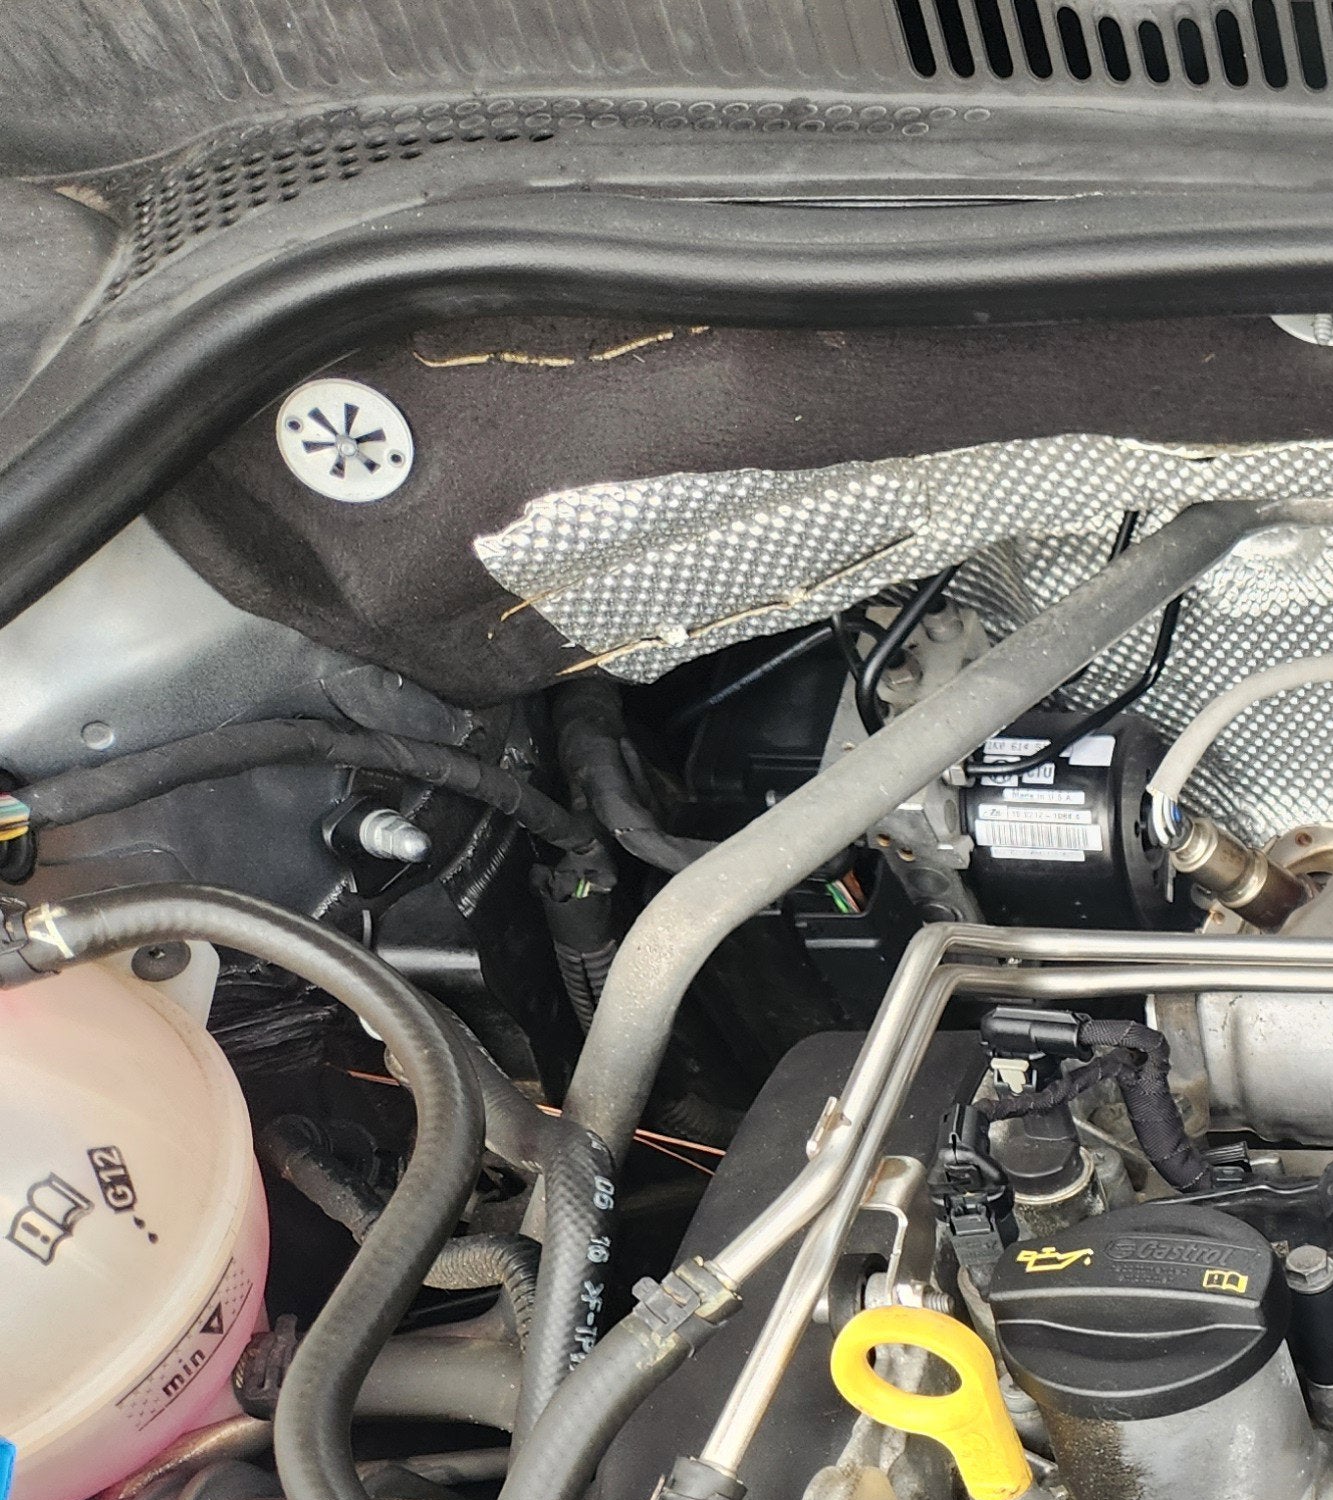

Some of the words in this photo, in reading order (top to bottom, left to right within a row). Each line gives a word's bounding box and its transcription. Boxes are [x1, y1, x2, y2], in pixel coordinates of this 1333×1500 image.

[92, 1149, 135, 1209] G12
[1138, 1239, 1234, 1266] Castrol
[162, 1349, 207, 1397] min
